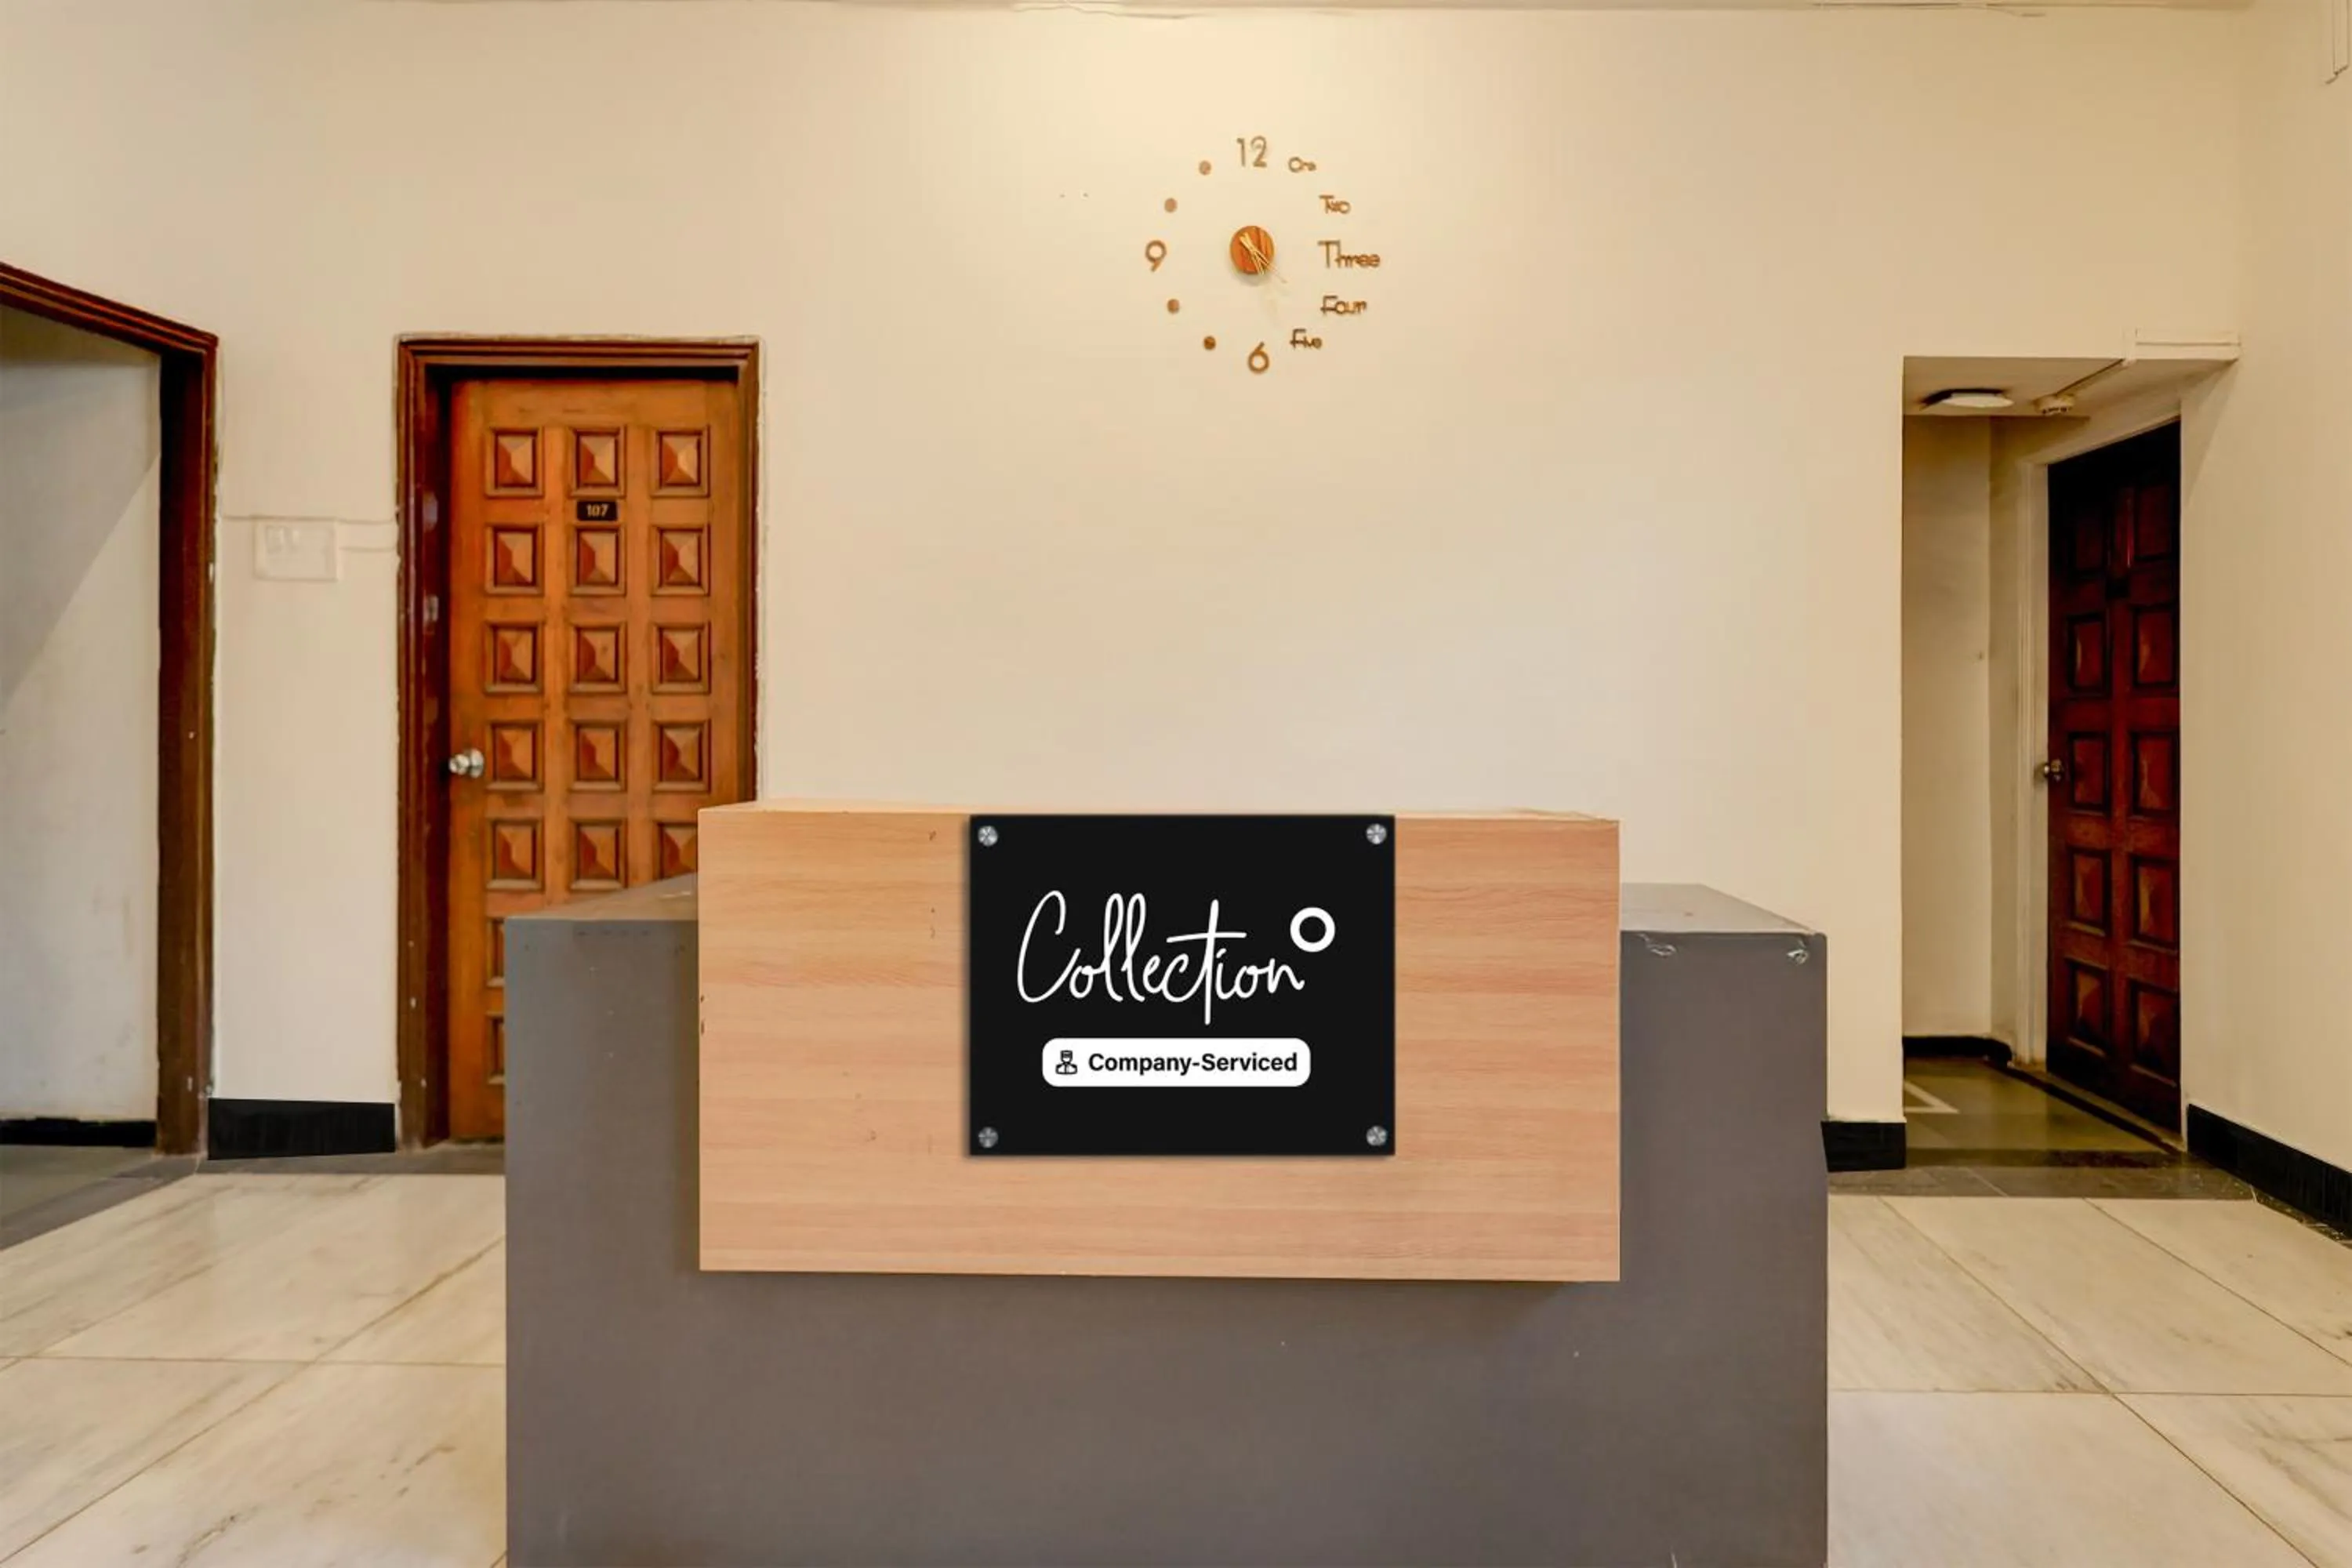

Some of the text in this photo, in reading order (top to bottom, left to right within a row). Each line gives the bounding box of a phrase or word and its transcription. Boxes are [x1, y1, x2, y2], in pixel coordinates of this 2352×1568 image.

[1236, 136, 1267, 167] 12
[1319, 194, 1351, 214] Two
[1145, 240, 1167, 272] 9
[1317, 240, 1381, 268] Three
[1320, 295, 1367, 315] Four
[1290, 328, 1323, 348] Five
[1247, 341, 1269, 374] 6
[586, 503, 609, 517] 107
[1017, 890, 1305, 1025] Collection
[1088, 1051, 1298, 1075] Company-Serviced
